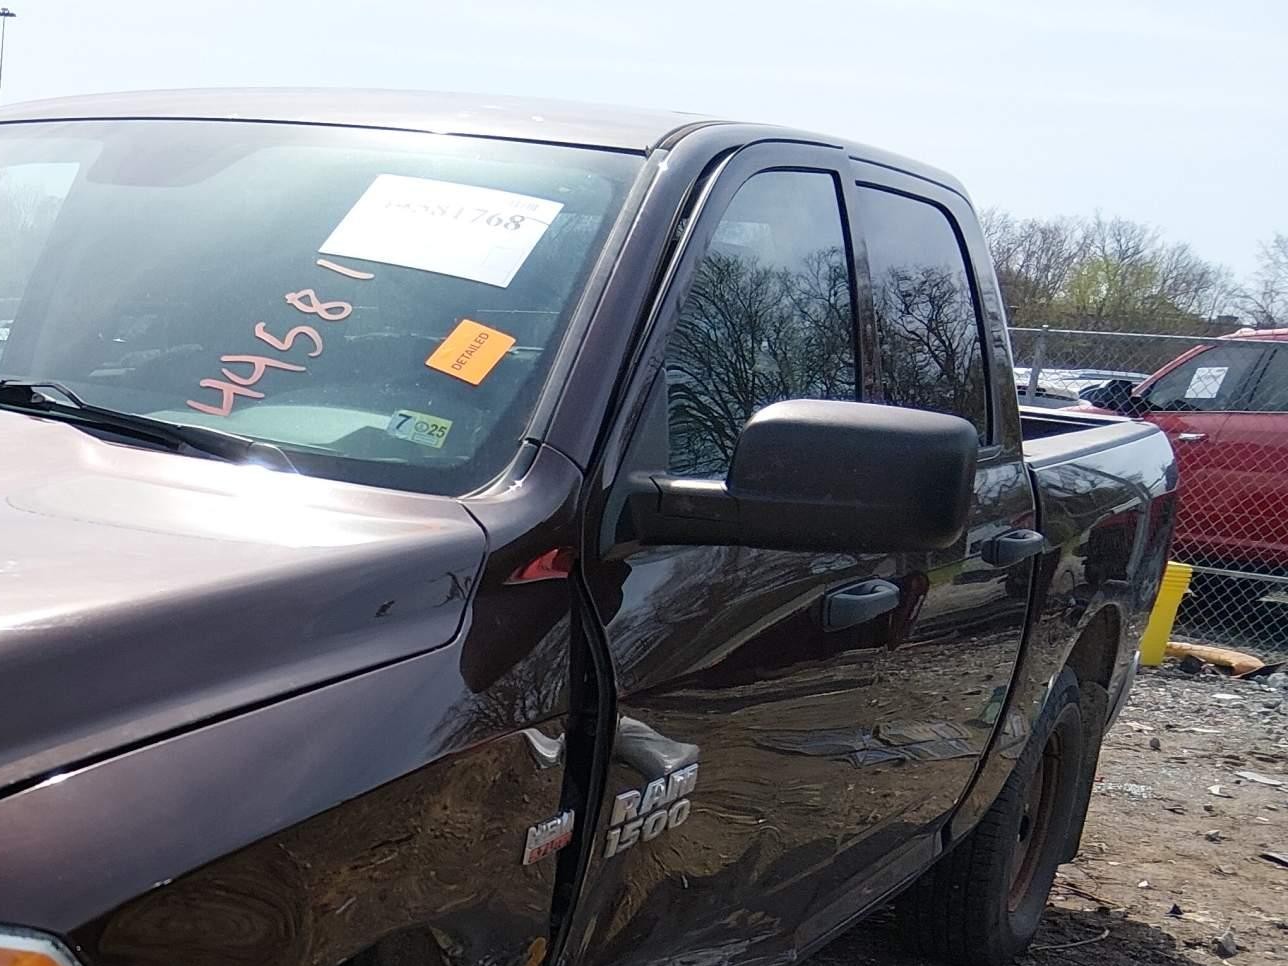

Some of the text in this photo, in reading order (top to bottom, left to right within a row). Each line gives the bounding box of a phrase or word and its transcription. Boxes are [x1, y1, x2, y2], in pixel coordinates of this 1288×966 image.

[187, 259, 375, 417] 44581
[451, 332, 489, 371] DETAILED
[396, 413, 447, 439] 7 25
[611, 763, 699, 826] RAM
[603, 798, 691, 859] 1500
